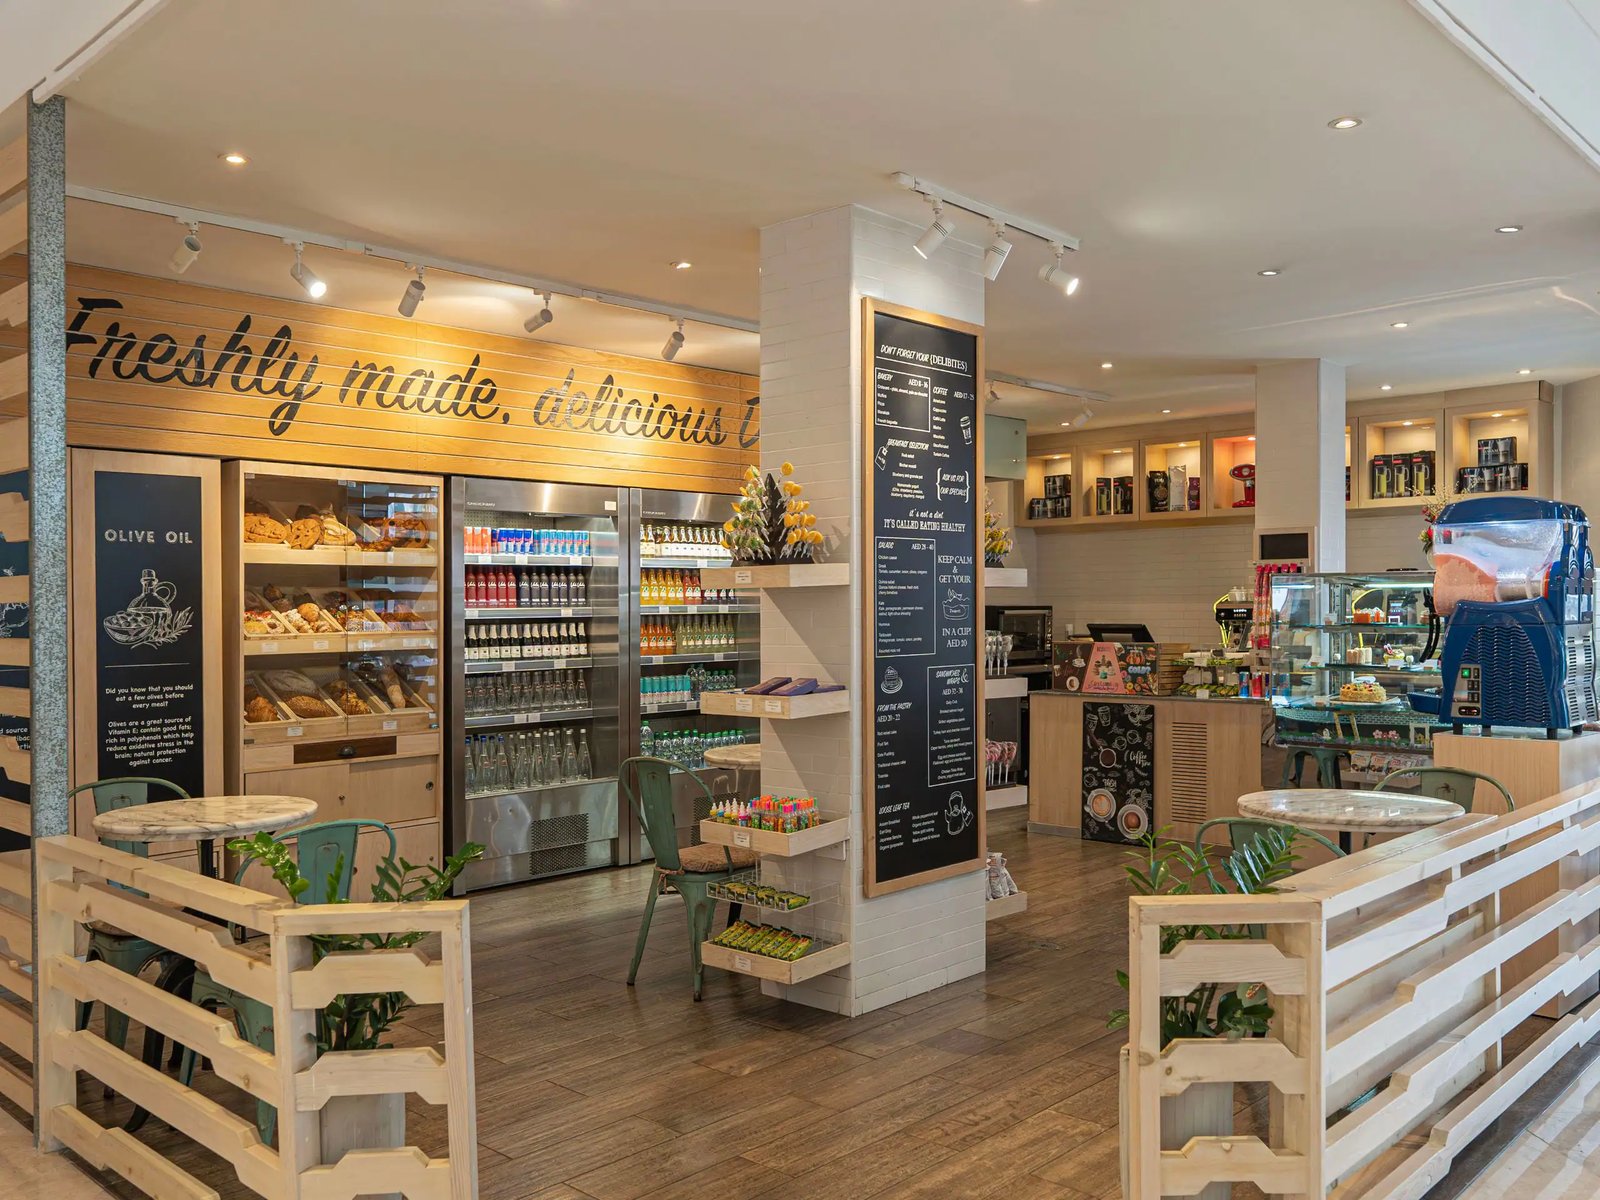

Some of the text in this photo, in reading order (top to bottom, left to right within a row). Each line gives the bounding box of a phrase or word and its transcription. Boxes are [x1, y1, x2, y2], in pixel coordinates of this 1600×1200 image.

[880, 344, 896, 355] DON'T
[897, 348, 916, 359] FORGET
[916, 352, 929, 362] YOUR
[66, 297, 323, 436] Freshly
[338, 354, 510, 424] made,
[533, 368, 728, 446] delicious
[877, 372, 893, 381] BAKERY
[933, 386, 948, 396] COFFEE
[887, 438, 929, 450] BREAKFAST SELECTION
[949, 488, 966, 496] SPECIALS
[884, 519, 966, 532] IT'S CALLED EATING HEALTHY
[104, 529, 192, 543] OLIVE OIL
[938, 555, 972, 564] KEEP CALM
[939, 575, 971, 583] GET YOUR
[942, 628, 950, 636] IN
[946, 639, 960, 647] AED
[935, 668, 969, 683] SANDWICHES &
[896, 702, 912, 710] PASTRY
[128, 734, 161, 743] polyphenols
[1130, 750, 1147, 764] Coffee
[129, 759, 150, 767] against
[879, 805, 892, 814] LOOSE
[893, 803, 902, 812] LEAF
